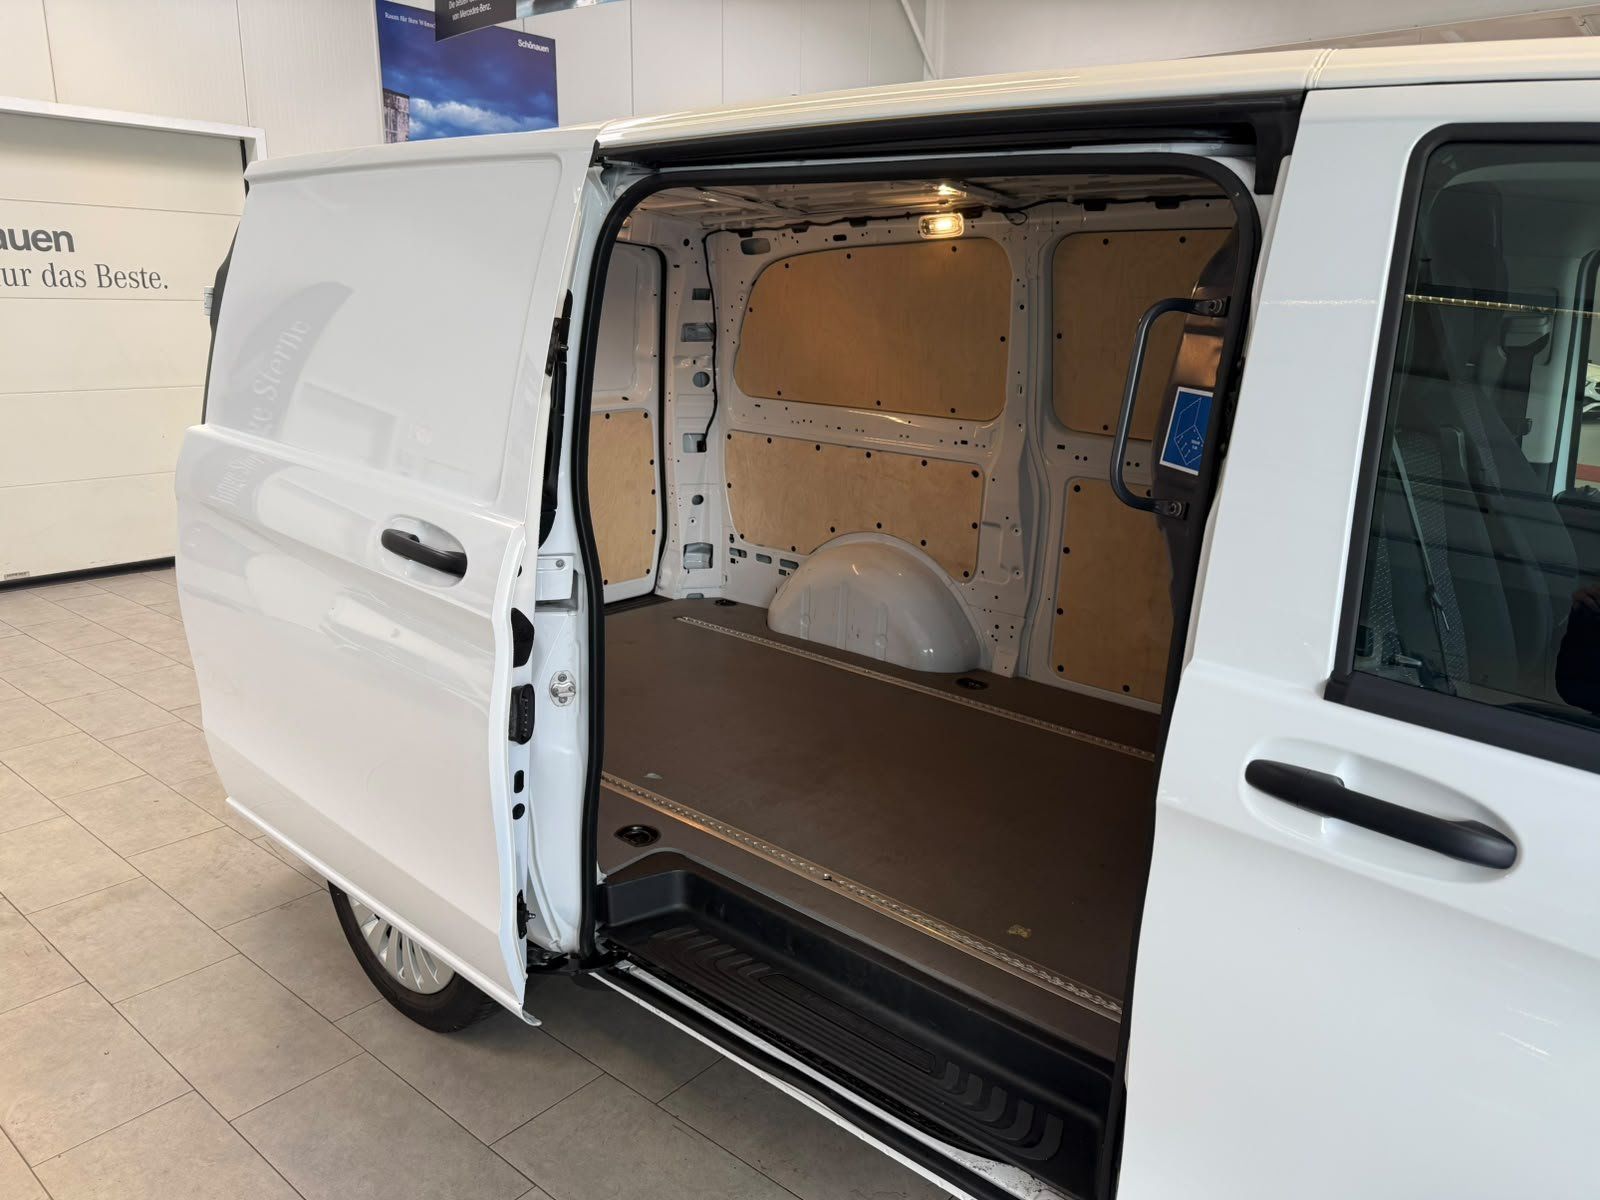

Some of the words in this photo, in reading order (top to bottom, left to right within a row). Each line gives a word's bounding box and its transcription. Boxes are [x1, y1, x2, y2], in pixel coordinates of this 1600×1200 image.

[385, 12, 399, 21] Raum
[517, 38, 550, 54] Schönauen
[0, 267, 32, 288] ur
[41, 262, 88, 289] das
[94, 263, 169, 291] Beste.
